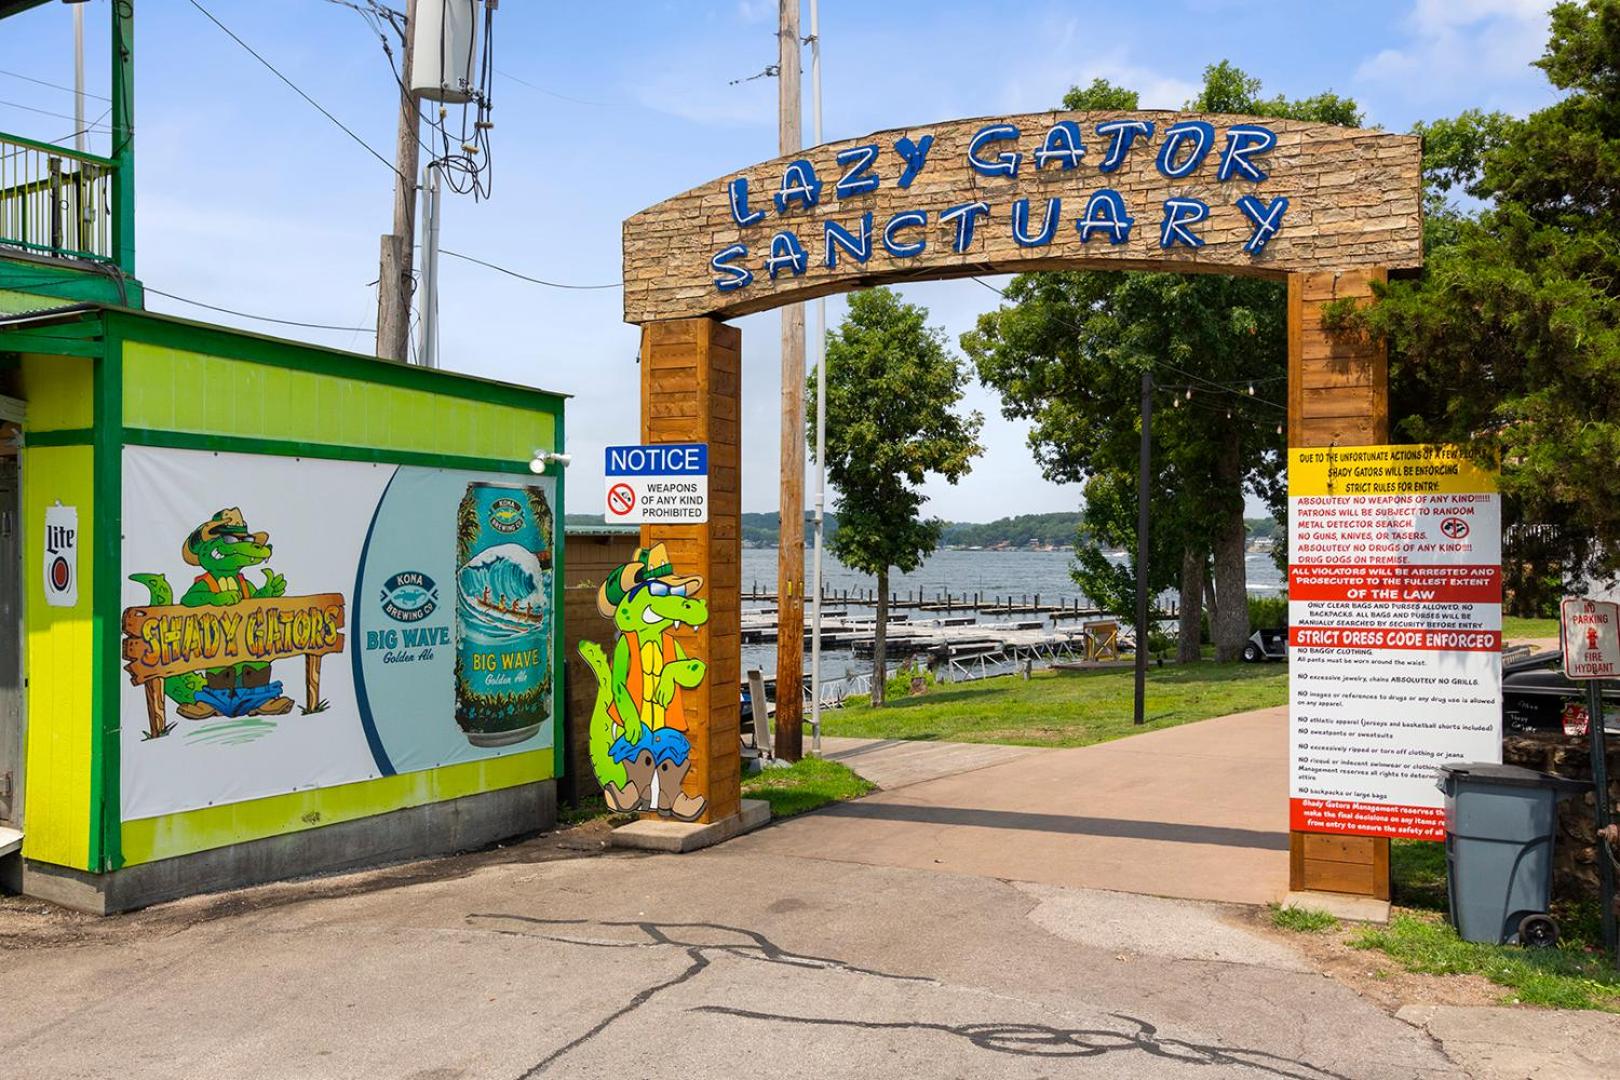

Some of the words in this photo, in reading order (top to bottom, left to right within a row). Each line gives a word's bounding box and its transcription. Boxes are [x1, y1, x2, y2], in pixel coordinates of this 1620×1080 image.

[728, 135, 935, 228] LAZY
[968, 120, 1278, 182] GATOR
[711, 188, 1290, 292] SANCTUARY
[611, 448, 700, 471] NOTICE
[1300, 454, 1314, 463] DUE
[1315, 453, 1324, 462] TO
[1326, 452, 1338, 462] THE
[1340, 451, 1388, 462] UNFORTUNATE
[1390, 450, 1421, 460] ACTIONS
[1424, 449, 1433, 460] OF
[1442, 450, 1458, 459] FEW
[1328, 468, 1352, 478] SHADY
[1354, 466, 1383, 476] GATORS
[1385, 466, 1402, 476] WILL
[1404, 466, 1413, 476] BE
[1416, 464, 1458, 476] ENFORCING
[647, 483, 698, 493] WEAPONS
[1346, 482, 1371, 492] STRICT
[1373, 482, 1396, 492] RULES
[1398, 482, 1412, 492] FOR
[641, 496, 654, 505] OF
[656, 496, 677, 505] ANY
[680, 496, 704, 505] KIND
[1298, 497, 1350, 505] ABSOLUTELY
[1353, 496, 1366, 504] NO
[1368, 496, 1413, 504] WEAPONS
[1416, 496, 1427, 504] OF
[1430, 495, 1449, 503] ANY
[642, 508, 702, 518] PROHIBITED
[1376, 508, 1417, 516] SUBJECT
[1420, 508, 1430, 516] TO
[1433, 506, 1474, 515] RANDOM
[1298, 520, 1324, 528] METAL
[46, 524, 74, 555] Lite
[1313, 532, 1338, 541] GUNS,
[1341, 532, 1373, 541] KNIVES,
[1376, 532, 1389, 540] OR
[1298, 544, 1350, 552] ABSOLUTELY
[1353, 544, 1366, 552] NO
[1368, 544, 1400, 552] DRUGS
[1403, 544, 1414, 552] OF
[1418, 544, 1437, 552] ANY
[396, 573, 423, 586] KONA
[1347, 588, 1367, 599] OF
[1371, 589, 1398, 599] THE
[1403, 590, 1435, 600] LAW
[386, 603, 424, 620] BREWING
[1584, 602, 1595, 613] NO
[1572, 614, 1608, 624] PARKING
[141, 611, 243, 667] SHADY
[245, 605, 341, 658] GATORS
[366, 628, 398, 650] BIG
[401, 626, 450, 648] WAVE
[1297, 630, 1340, 644] STRICT
[1342, 630, 1383, 646] DRESS
[1386, 631, 1422, 646] CODE
[1426, 632, 1494, 648] ENFORCED
[383, 651, 414, 664] Golden
[418, 648, 434, 660] Ale
[472, 653, 497, 672] BIG
[502, 648, 539, 670] WAVE
[1584, 652, 1603, 662] FIRE
[1575, 662, 1614, 674] HYDRANT
[484, 674, 512, 686] Golden
[514, 669, 528, 683] Ale
[1302, 799, 1324, 808] Shady
[1325, 801, 1350, 809] Gators
[1352, 802, 1399, 812] Management
[1400, 806, 1434, 815] reserves
